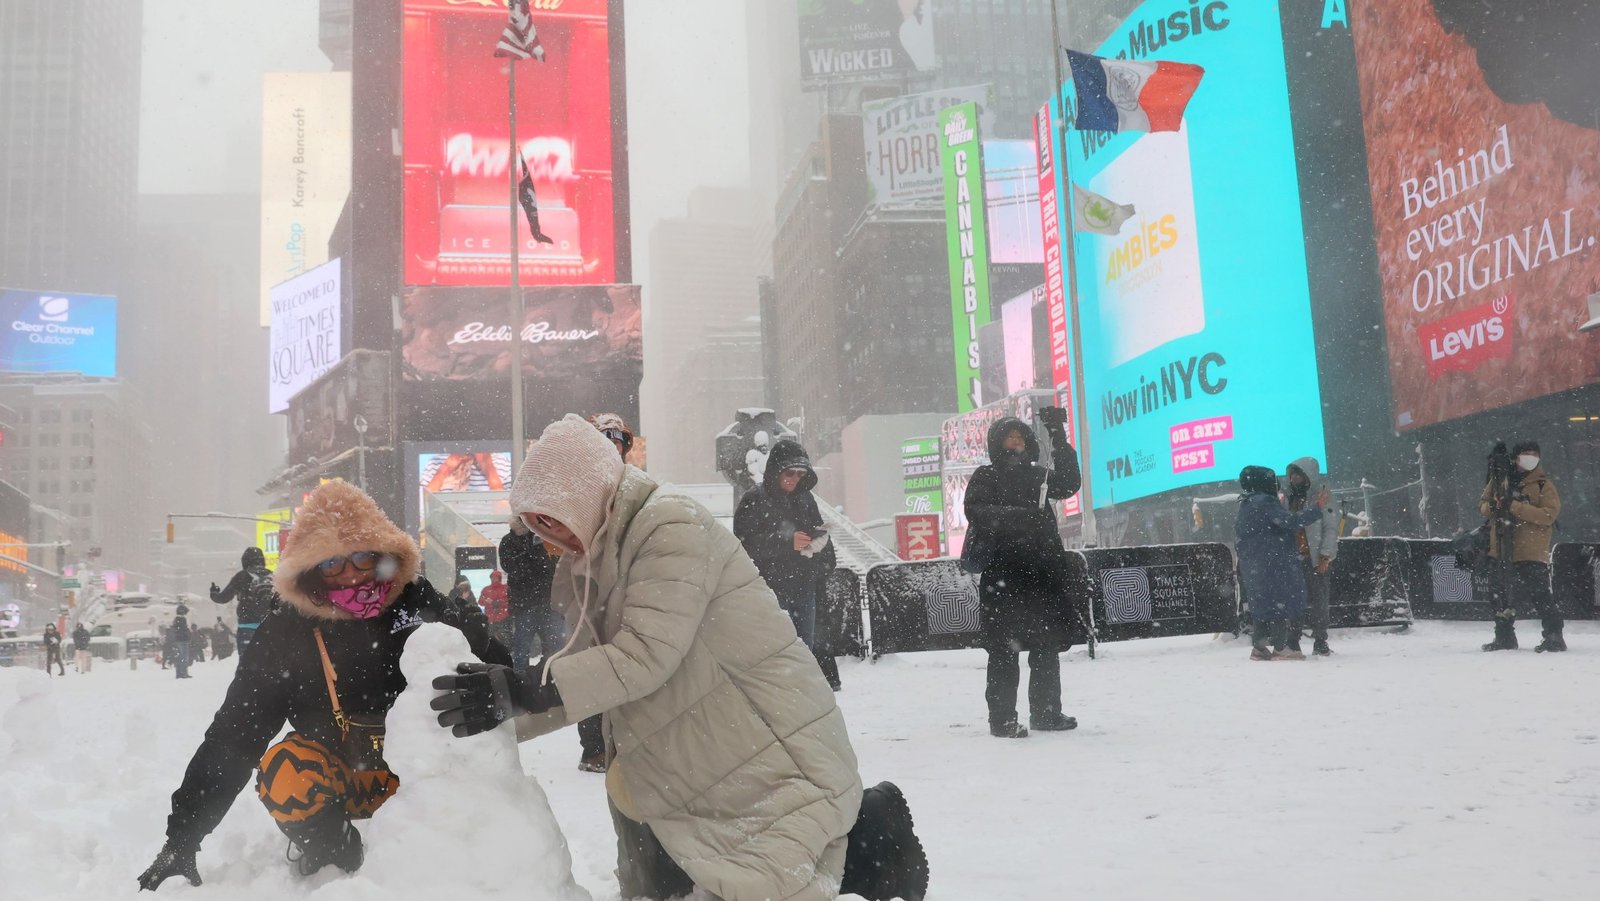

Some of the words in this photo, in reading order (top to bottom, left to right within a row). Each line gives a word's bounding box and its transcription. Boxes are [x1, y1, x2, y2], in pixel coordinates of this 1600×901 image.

[1129, 0, 1230, 60] Music
[292, 107, 305, 164] Bancroft
[877, 97, 935, 136] LITTLE
[879, 133, 939, 190] HORR
[1400, 123, 1514, 221] Behind
[292, 168, 307, 208] Karey
[1042, 189, 1059, 242] FREE
[1406, 197, 1486, 261] every
[452, 238, 491, 249] ICE
[526, 239, 571, 251] OLD
[954, 150, 980, 369] CANNABIS
[1105, 211, 1178, 285] AMBIES
[1412, 208, 1595, 313] ORIGINAL.
[272, 285, 320, 316] WELCOME
[322, 279, 336, 296] TO
[1046, 243, 1068, 370] CHOCOLATE
[12, 320, 45, 332] Clear
[46, 323, 95, 336] Channel
[29, 333, 76, 345] Outdoor
[297, 305, 335, 339] TIMES
[272, 330, 335, 385] SQUARE
[1101, 389, 1138, 430] Now
[1140, 375, 1159, 415] in
[1160, 352, 1228, 407] NYC
[1106, 454, 1134, 481] TPA
[907, 517, 934, 560] tkt
[1153, 587, 1189, 599] SQUARE
[1154, 575, 1186, 588] TIMES
[1157, 599, 1188, 608] ALLIANCE
